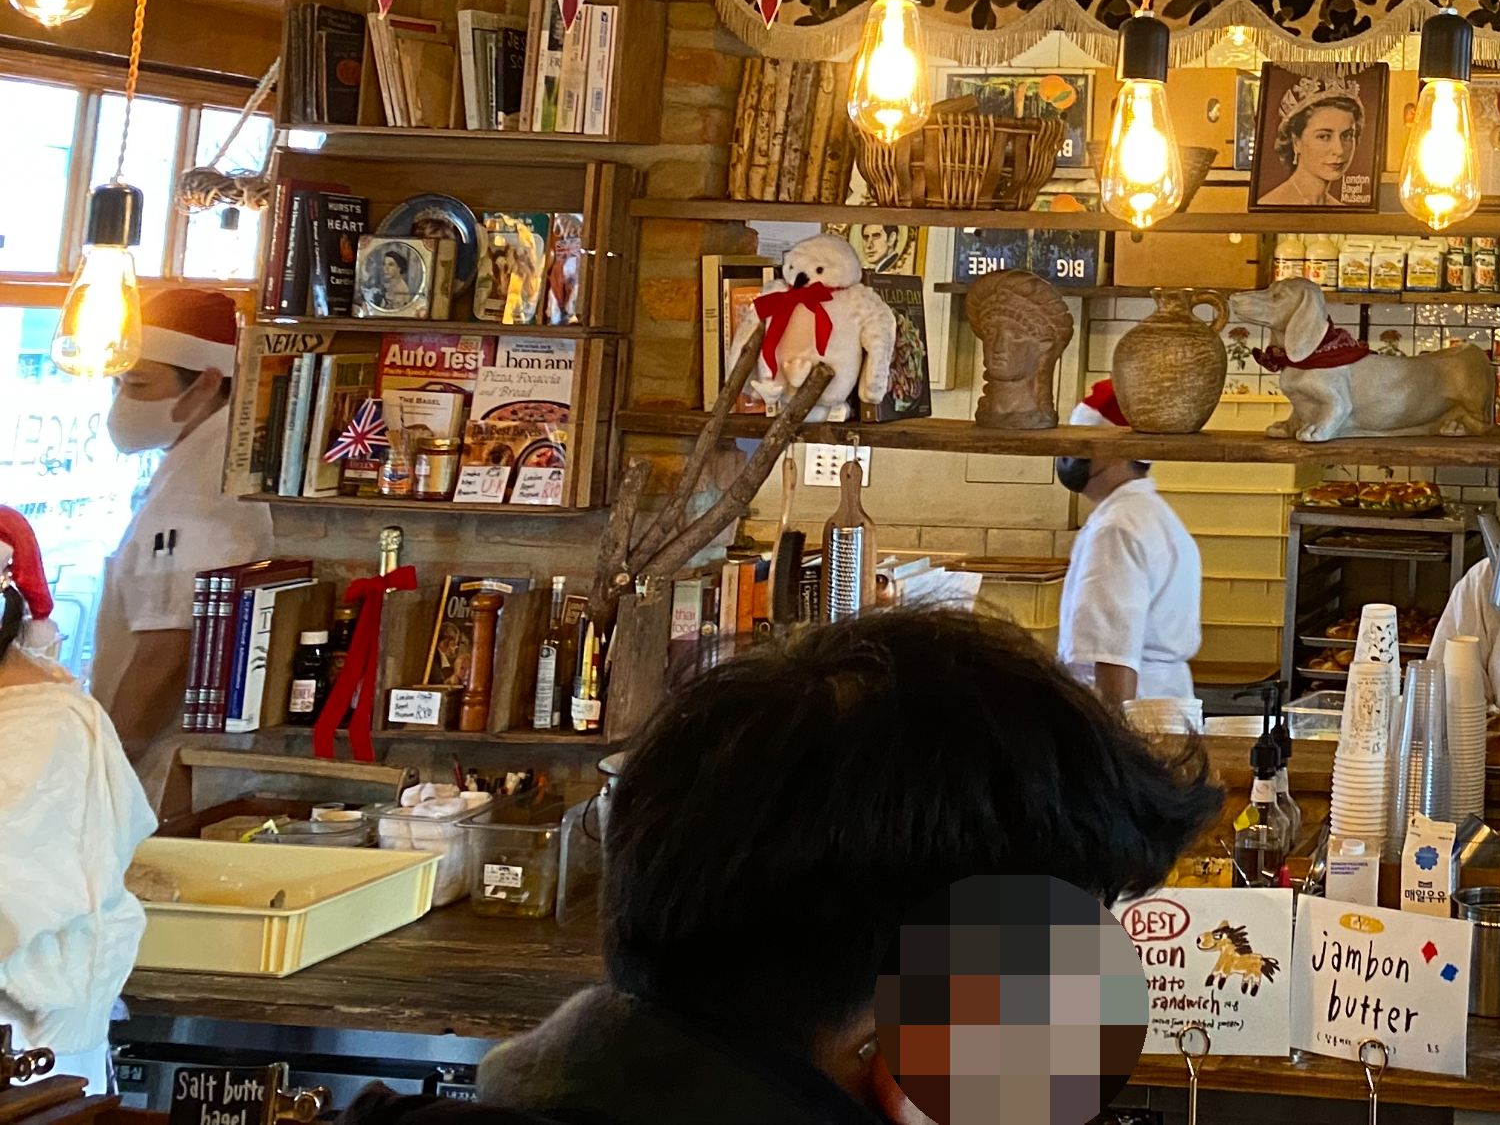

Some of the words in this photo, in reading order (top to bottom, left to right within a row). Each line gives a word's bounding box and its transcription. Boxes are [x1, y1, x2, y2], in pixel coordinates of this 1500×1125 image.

[1342, 174, 1370, 184] London
[1342, 184, 1362, 195] Bagel
[1341, 193, 1371, 203] Museum
[327, 219, 364, 232] HEART
[1056, 259, 1085, 278] BIG
[384, 344, 437, 368] Auto
[441, 346, 485, 370] Test
[506, 351, 542, 369] bon
[499, 385, 537, 398] Bread
[399, 396, 414, 404] THE
[675, 609, 696, 620] thai
[1404, 889, 1447, 904] 매일우유
[1132, 909, 1177, 936] BEST
[1312, 930, 1410, 983] jambon
[1151, 989, 1220, 1016] sandwich
[1328, 979, 1418, 1033] butter
[177, 1072, 217, 1101] Salt
